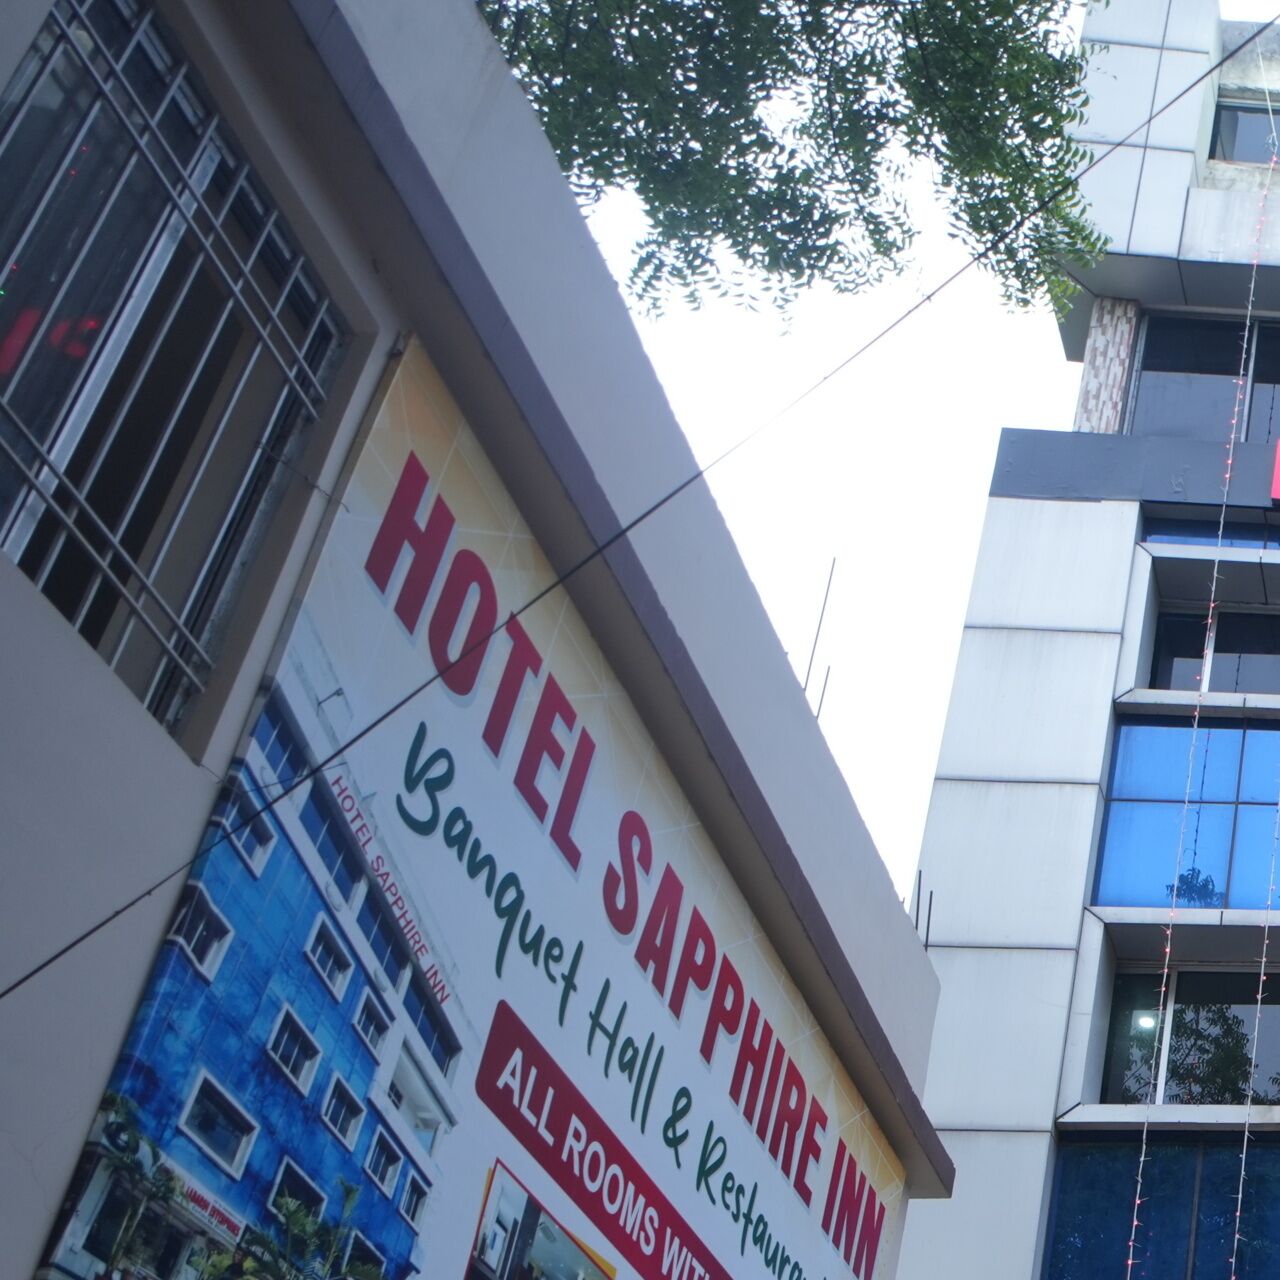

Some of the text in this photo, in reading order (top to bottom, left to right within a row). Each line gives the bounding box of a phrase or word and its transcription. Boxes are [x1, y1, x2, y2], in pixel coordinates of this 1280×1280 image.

[331, 775, 451, 1007] HOTEL SAPPHIRE INN
[363, 448, 597, 873] HOTEL
[602, 808, 830, 1208] SAPPHIRE
[395, 720, 584, 1028] Banquet
[584, 977, 666, 1135] Hall
[662, 1085, 694, 1170] &
[496, 1046, 554, 1148] ALL
[562, 1120, 658, 1256] ROOMS
